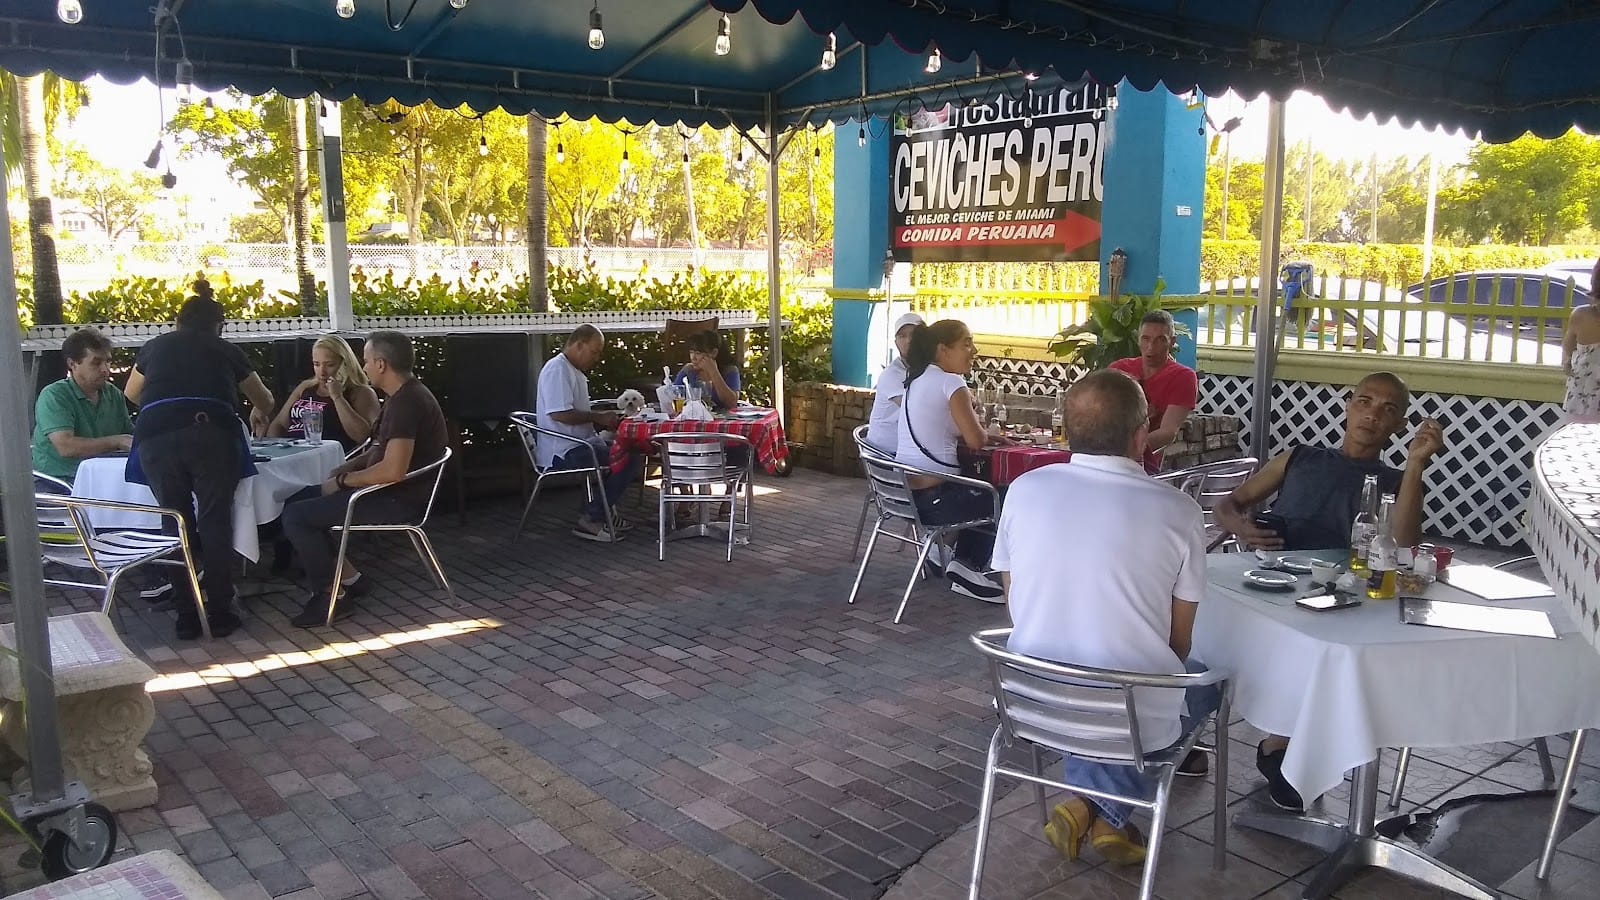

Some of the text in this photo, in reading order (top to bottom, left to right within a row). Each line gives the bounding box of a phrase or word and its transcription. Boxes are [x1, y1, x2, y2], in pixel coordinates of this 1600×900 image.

[894, 129, 1023, 213] CEVICHES
[905, 208, 1056, 225] EL MEJOR CEVICHE DE MIAMI
[902, 224, 1056, 243] COMIDA PERUANA
